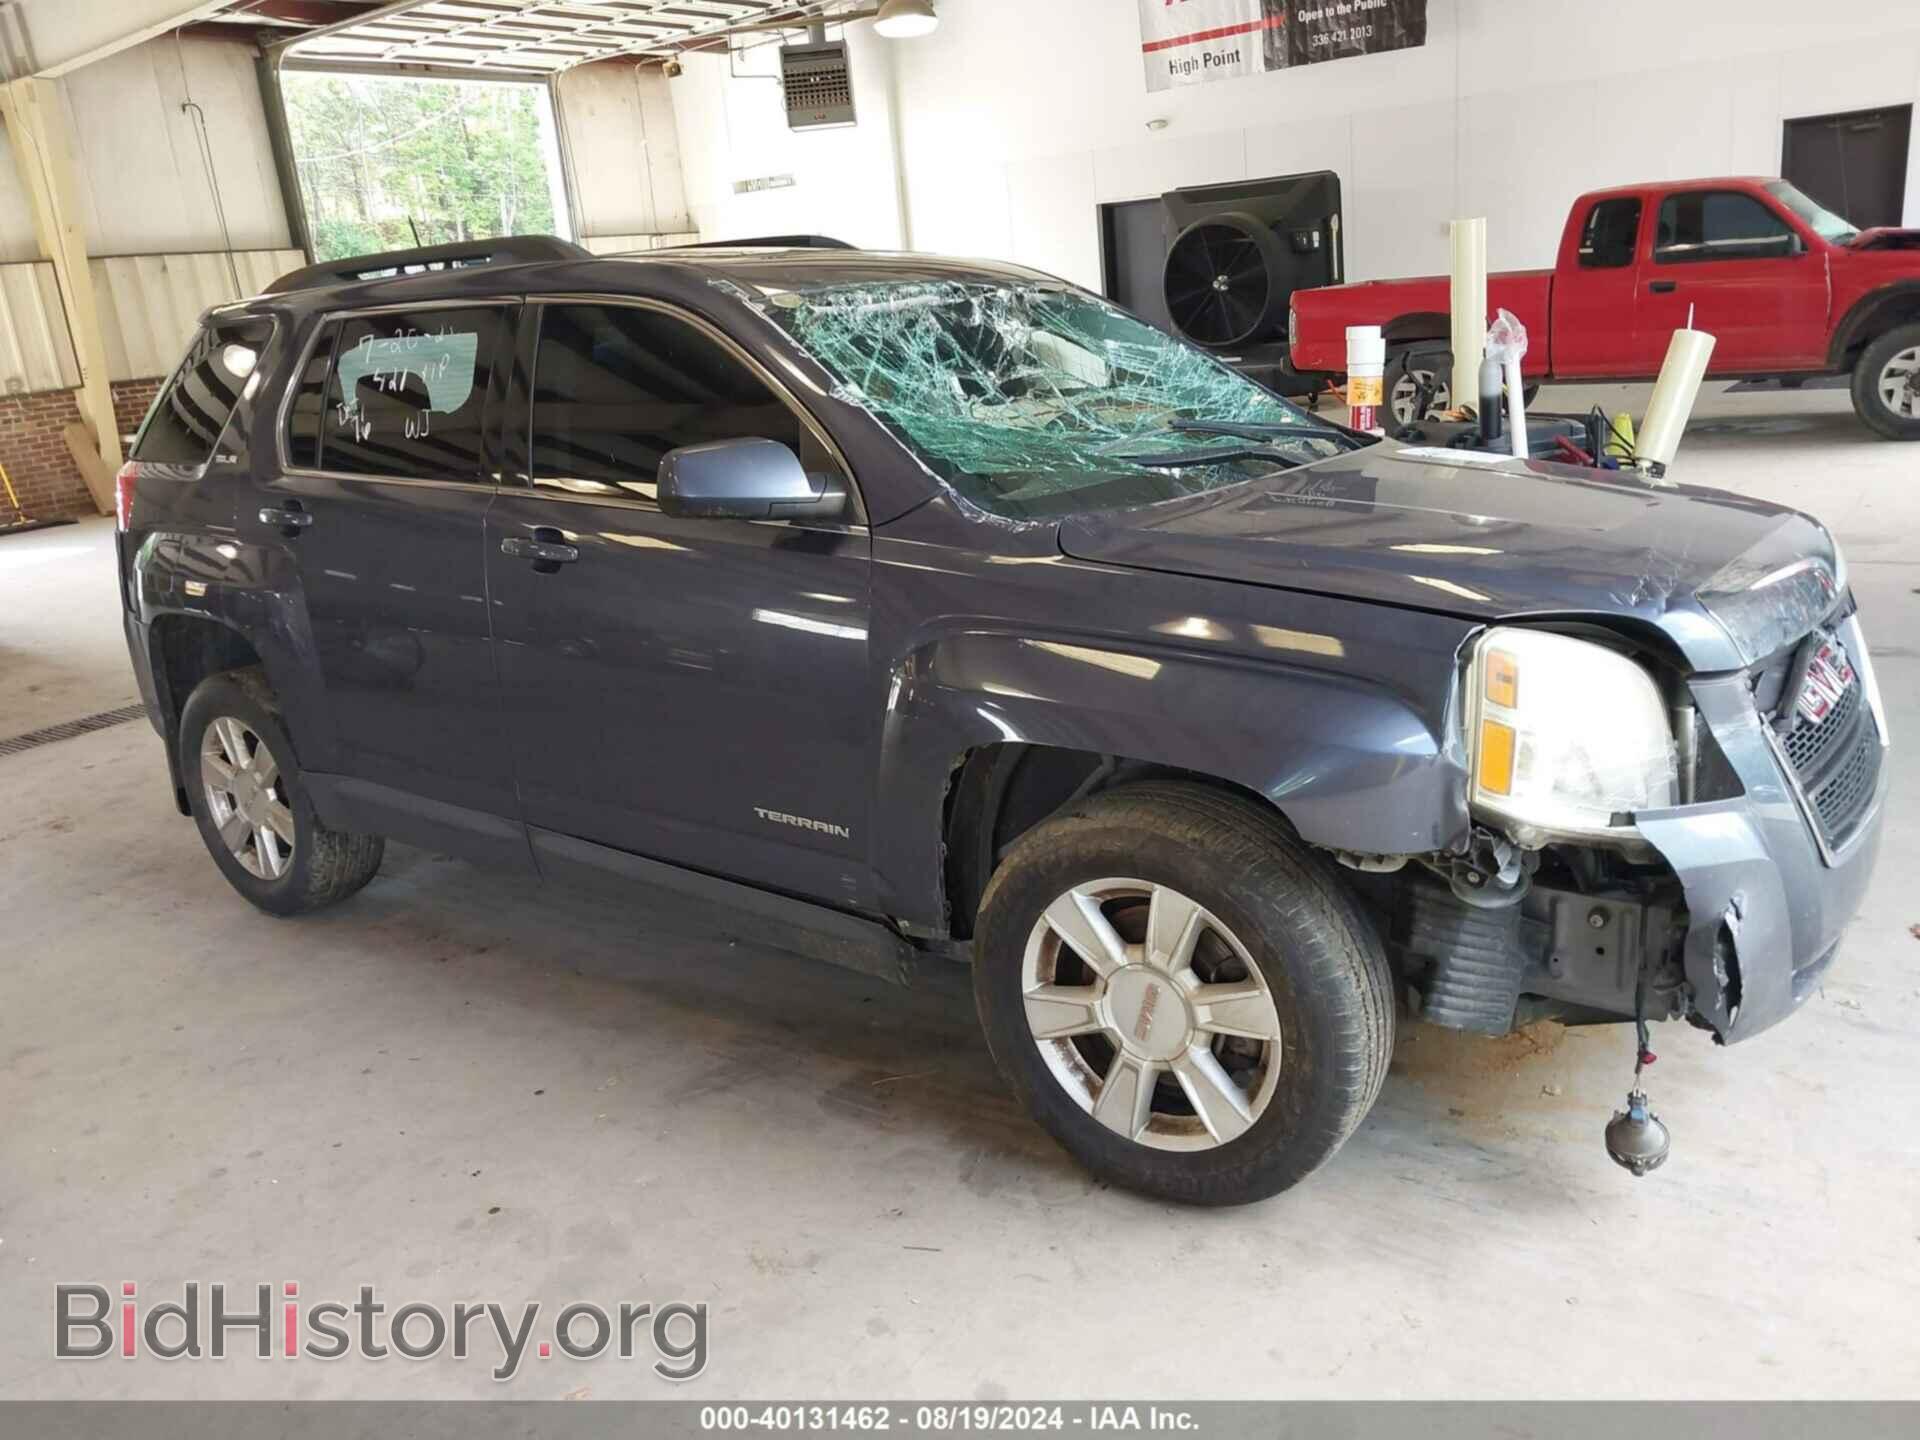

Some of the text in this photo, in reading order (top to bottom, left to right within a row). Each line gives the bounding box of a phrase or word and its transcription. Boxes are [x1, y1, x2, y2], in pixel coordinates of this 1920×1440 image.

[1298, 0, 1387, 24] Open to the Public
[1168, 49, 1241, 76] High Point
[753, 806, 850, 839] TERRAIN
